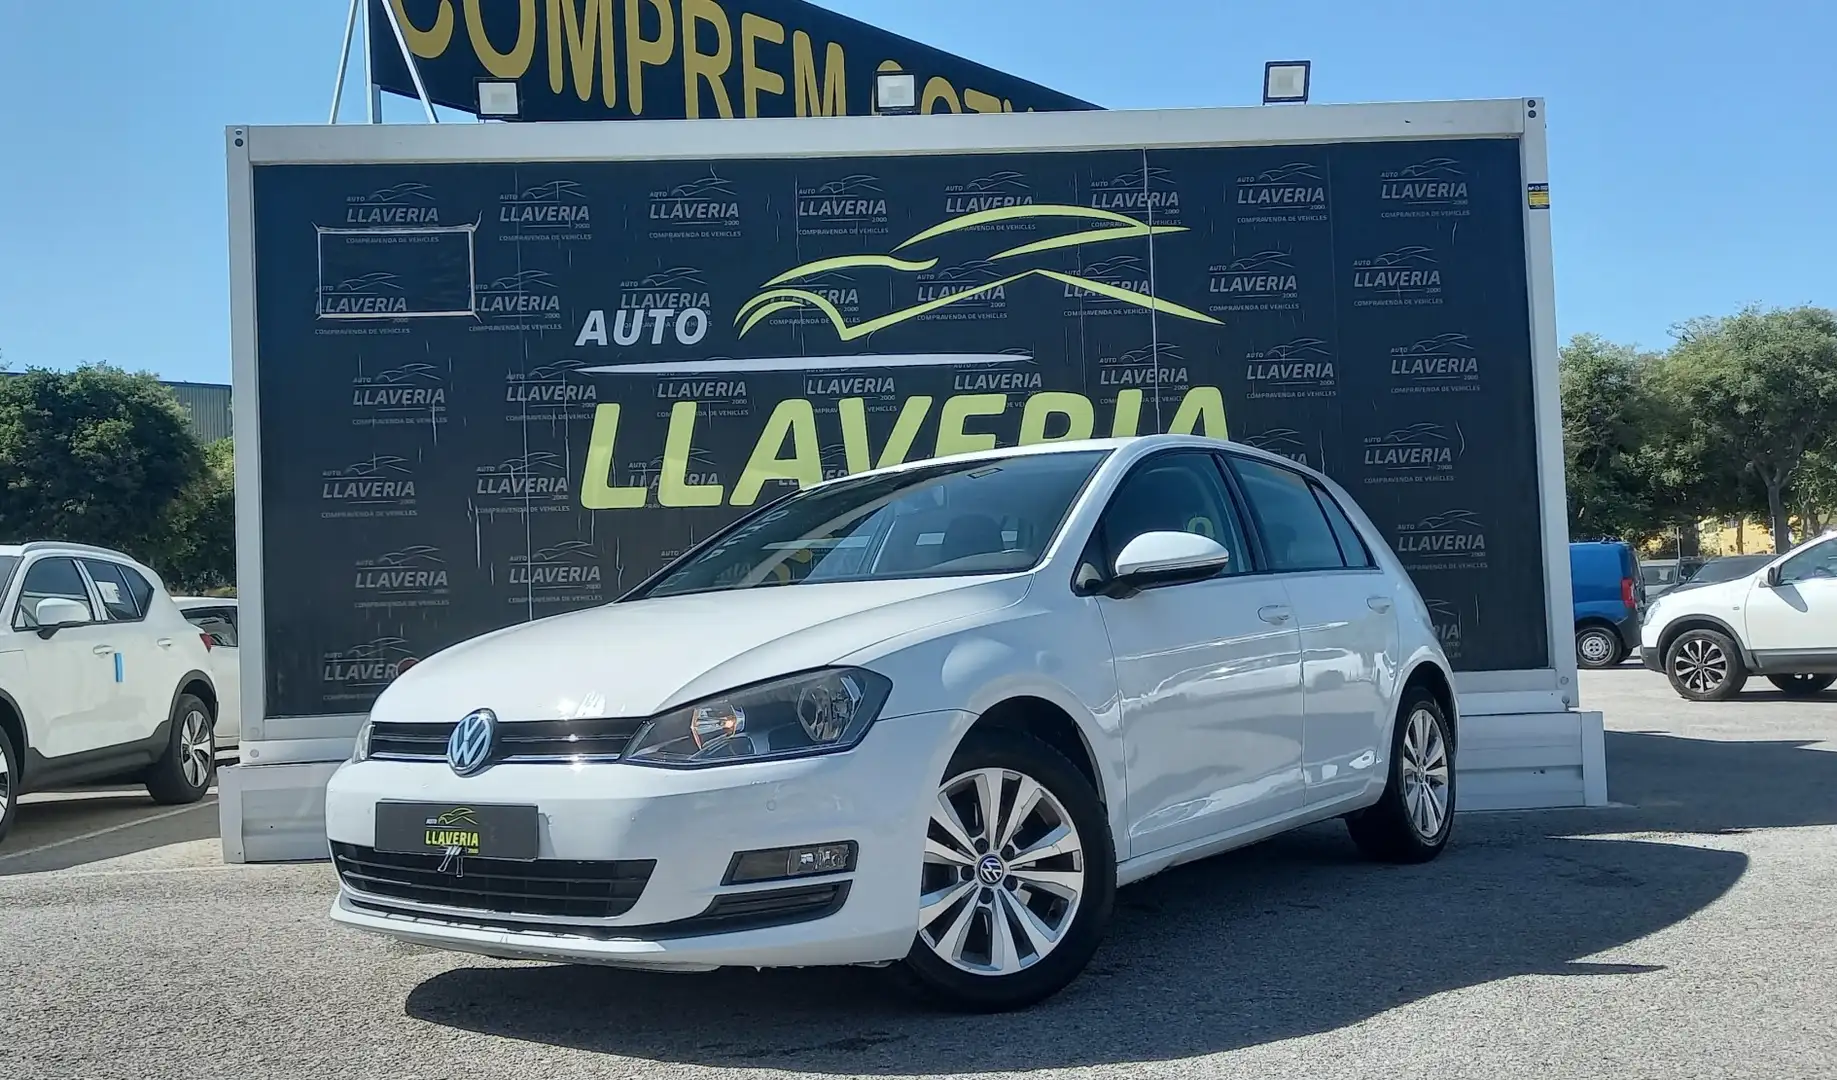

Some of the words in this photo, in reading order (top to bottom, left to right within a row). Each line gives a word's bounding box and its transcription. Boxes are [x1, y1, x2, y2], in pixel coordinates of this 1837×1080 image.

[1238, 187, 1324, 204] LLAVERIA
[1381, 182, 1467, 198] LLAVERIA
[798, 200, 886, 216] LLAVERIA
[1092, 192, 1179, 208] LLAVERIA
[346, 207, 438, 222] LLAVERIA
[500, 206, 589, 221] LLAVERIA
[650, 203, 738, 219] LLAVERIA
[1210, 276, 1296, 292] LLAVERIA
[1354, 270, 1440, 287] LLAVERIA
[621, 292, 710, 308] LLAVERIA
[575, 308, 707, 346] AUTO
[1247, 363, 1333, 379] LLAVERIA
[1391, 358, 1477, 374] LLAVERIA
[954, 373, 1042, 390] LLAVERIA
[1100, 368, 1188, 384] LLAVERIA
[506, 384, 597, 402] LLAVERIA
[657, 381, 746, 398] LLAVERIA
[807, 378, 895, 394] LLAVERIA
[353, 388, 445, 405] LLAVERIA
[1364, 447, 1451, 464] LLAVERIA
[323, 481, 415, 498] LLAVERIA
[477, 477, 567, 494] LLAVERIA
[1398, 534, 1485, 551] LLAVERIA
[355, 571, 447, 588] LLAVERIA
[510, 566, 600, 583] LLAVERIA
[324, 664, 397, 680] LLAVER
[425, 831, 479, 847] LLAVERIA
